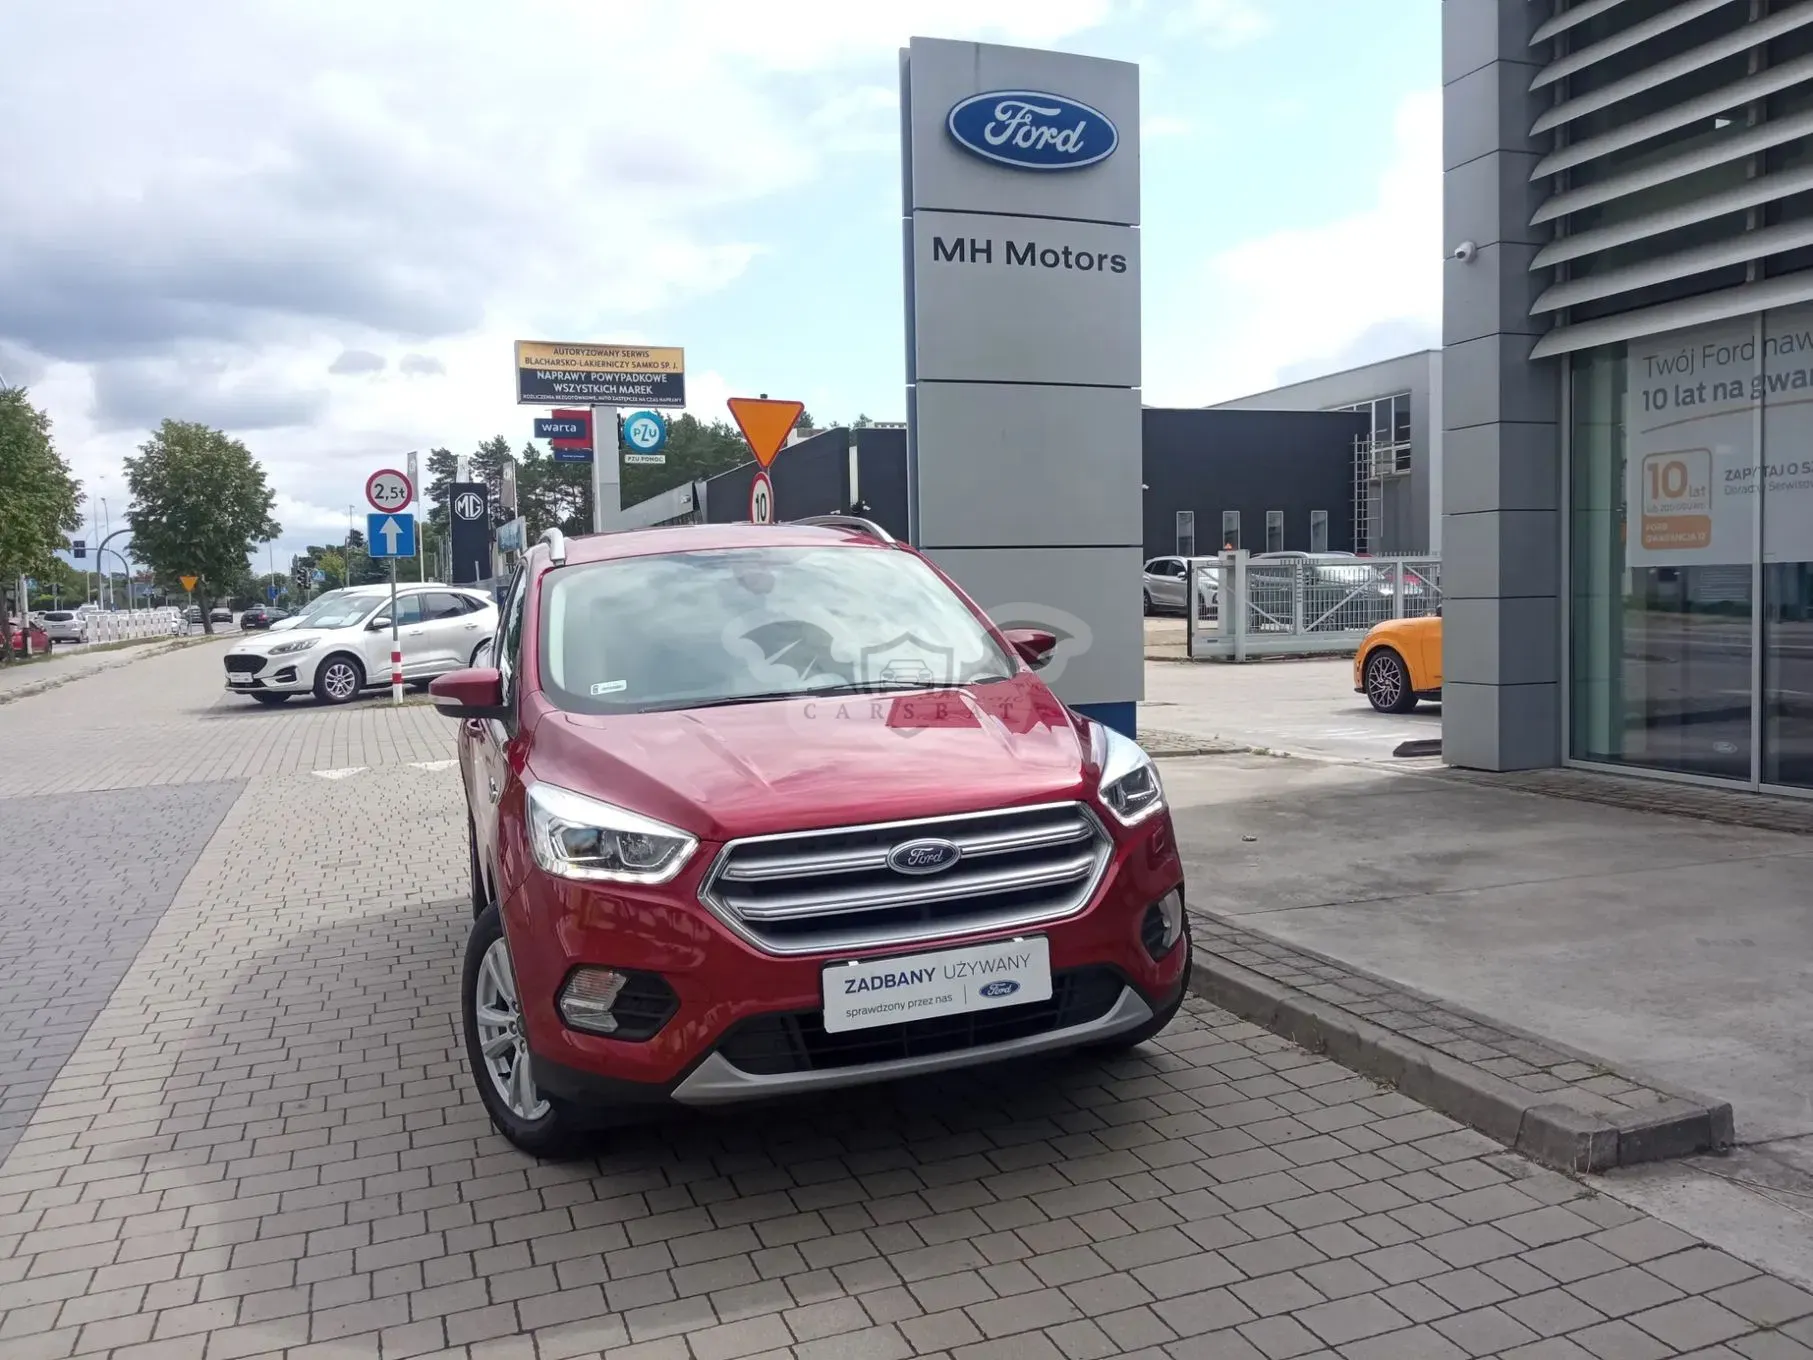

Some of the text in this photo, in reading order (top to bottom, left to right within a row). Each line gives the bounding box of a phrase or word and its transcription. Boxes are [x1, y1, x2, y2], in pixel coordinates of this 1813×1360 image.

[984, 100, 1087, 154] Ford
[933, 236, 1127, 274] MH Motors
[553, 348, 650, 358] AUTORYZOWANY SERWIS
[1642, 348, 1695, 378] Twój
[1702, 335, 1755, 369] Ford
[631, 361, 659, 369] SAMKO
[536, 370, 667, 383] NAPRAWY POWYPADKOWE
[553, 382, 653, 395] WSZYSTKICH MAREK
[1642, 387, 1668, 411] 10
[1674, 380, 1707, 407] lat
[1713, 378, 1744, 402] na
[541, 423, 577, 432] warta
[633, 424, 657, 441] PZU
[1787, 462, 1799, 476] O
[1646, 461, 1688, 499] 10
[374, 483, 406, 502] 2,5t
[457, 495, 481, 518] MG
[755, 493, 767, 522] 10
[907, 847, 944, 866] Ford
[844, 953, 1031, 994] ZADBANY UŻYWANY
[987, 983, 1012, 996] Ford
[846, 993, 953, 1018] sprawdzony przez nas
